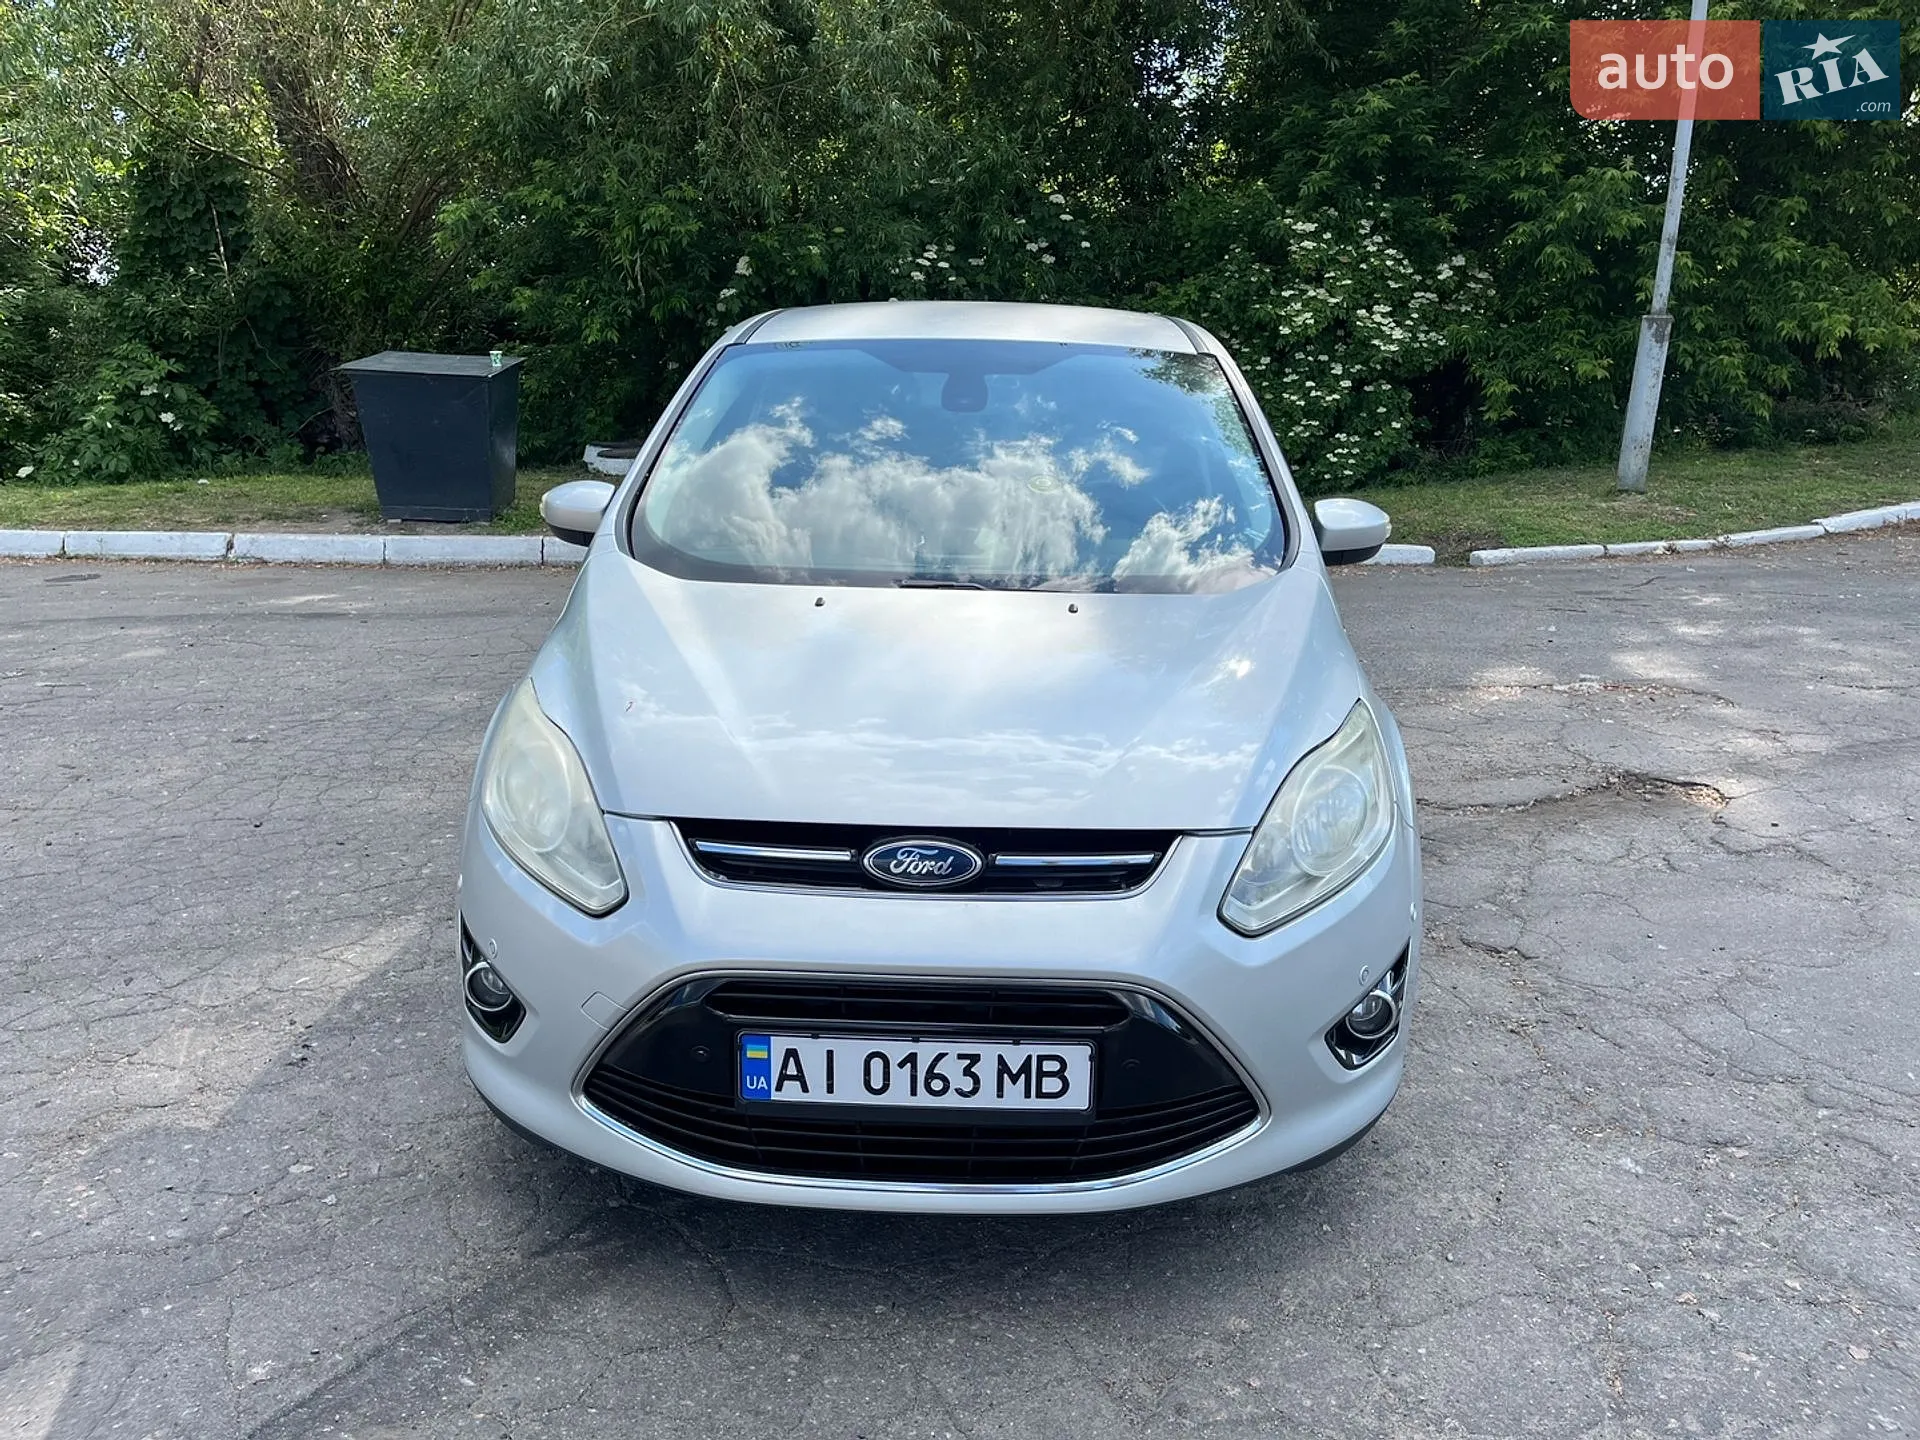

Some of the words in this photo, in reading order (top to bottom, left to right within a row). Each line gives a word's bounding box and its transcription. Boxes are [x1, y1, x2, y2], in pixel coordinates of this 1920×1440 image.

[890, 847, 955, 876] Ford
[746, 1075, 768, 1091] UA
[774, 1047, 835, 1095] AI
[863, 1050, 982, 1098] 0163
[996, 1053, 1070, 1100] MB
